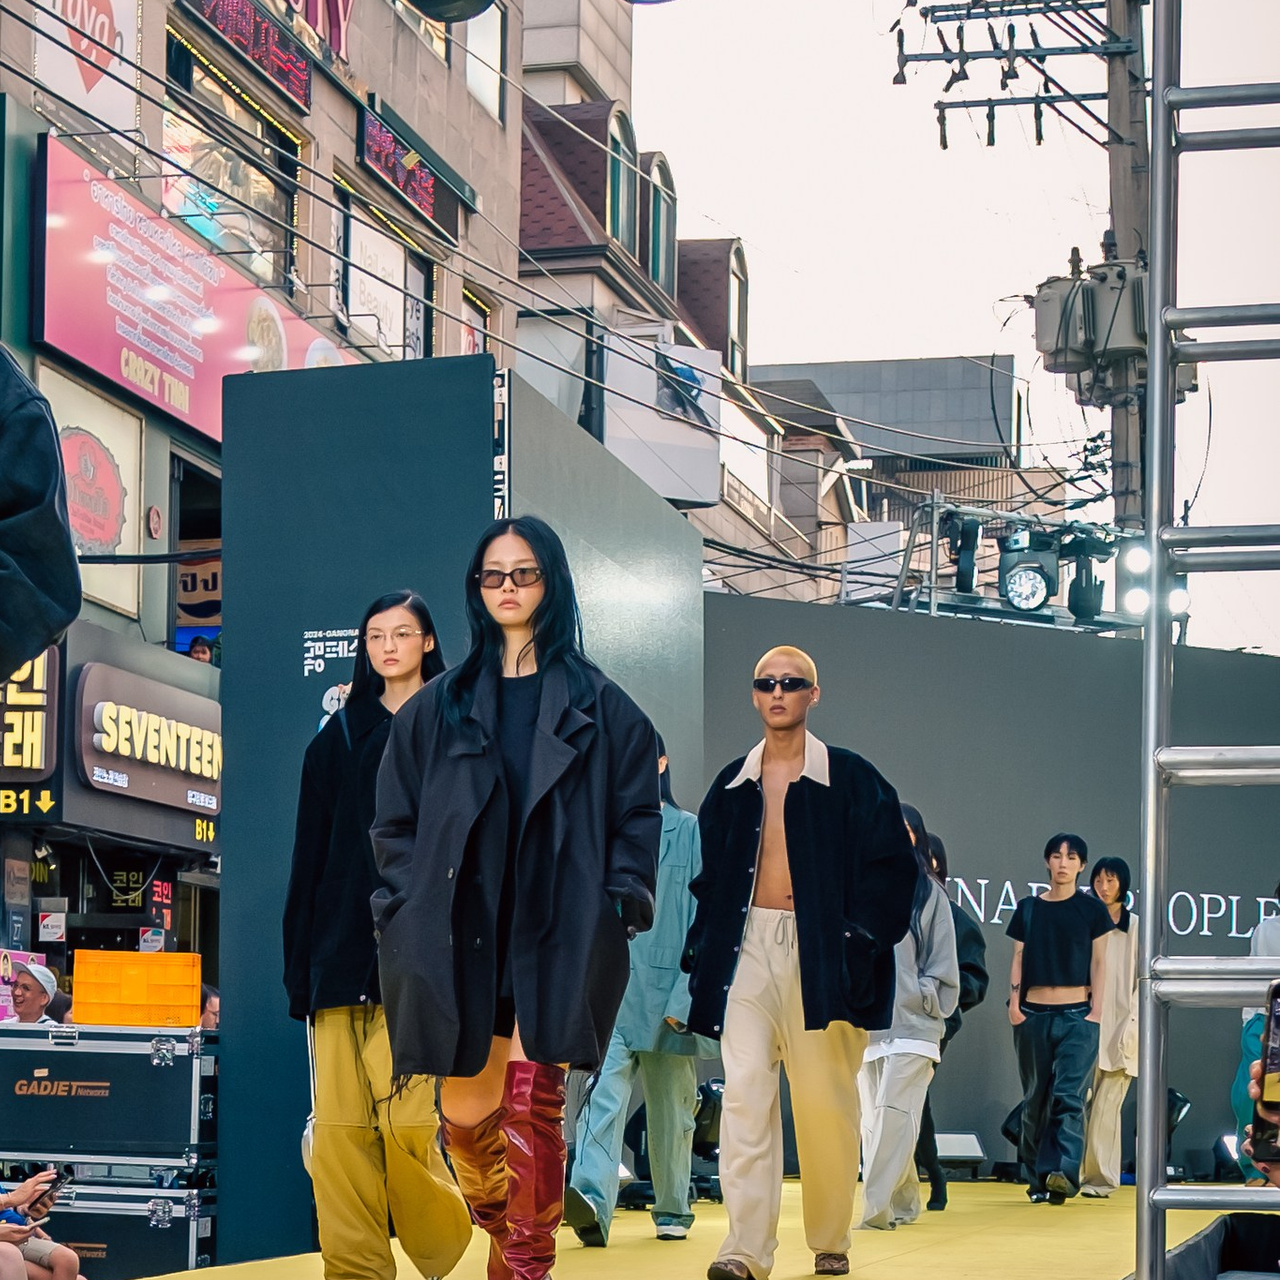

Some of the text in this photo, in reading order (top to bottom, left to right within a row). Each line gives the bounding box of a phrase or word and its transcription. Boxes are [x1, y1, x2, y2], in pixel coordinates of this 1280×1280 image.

[121, 347, 161, 397] CRAZY
[0, 789, 31, 814] B1
[195, 819, 208, 842] B1
[113, 871, 143, 888] 코인
[152, 880, 172, 904] 코인
[14, 1080, 78, 1096] GADJET
